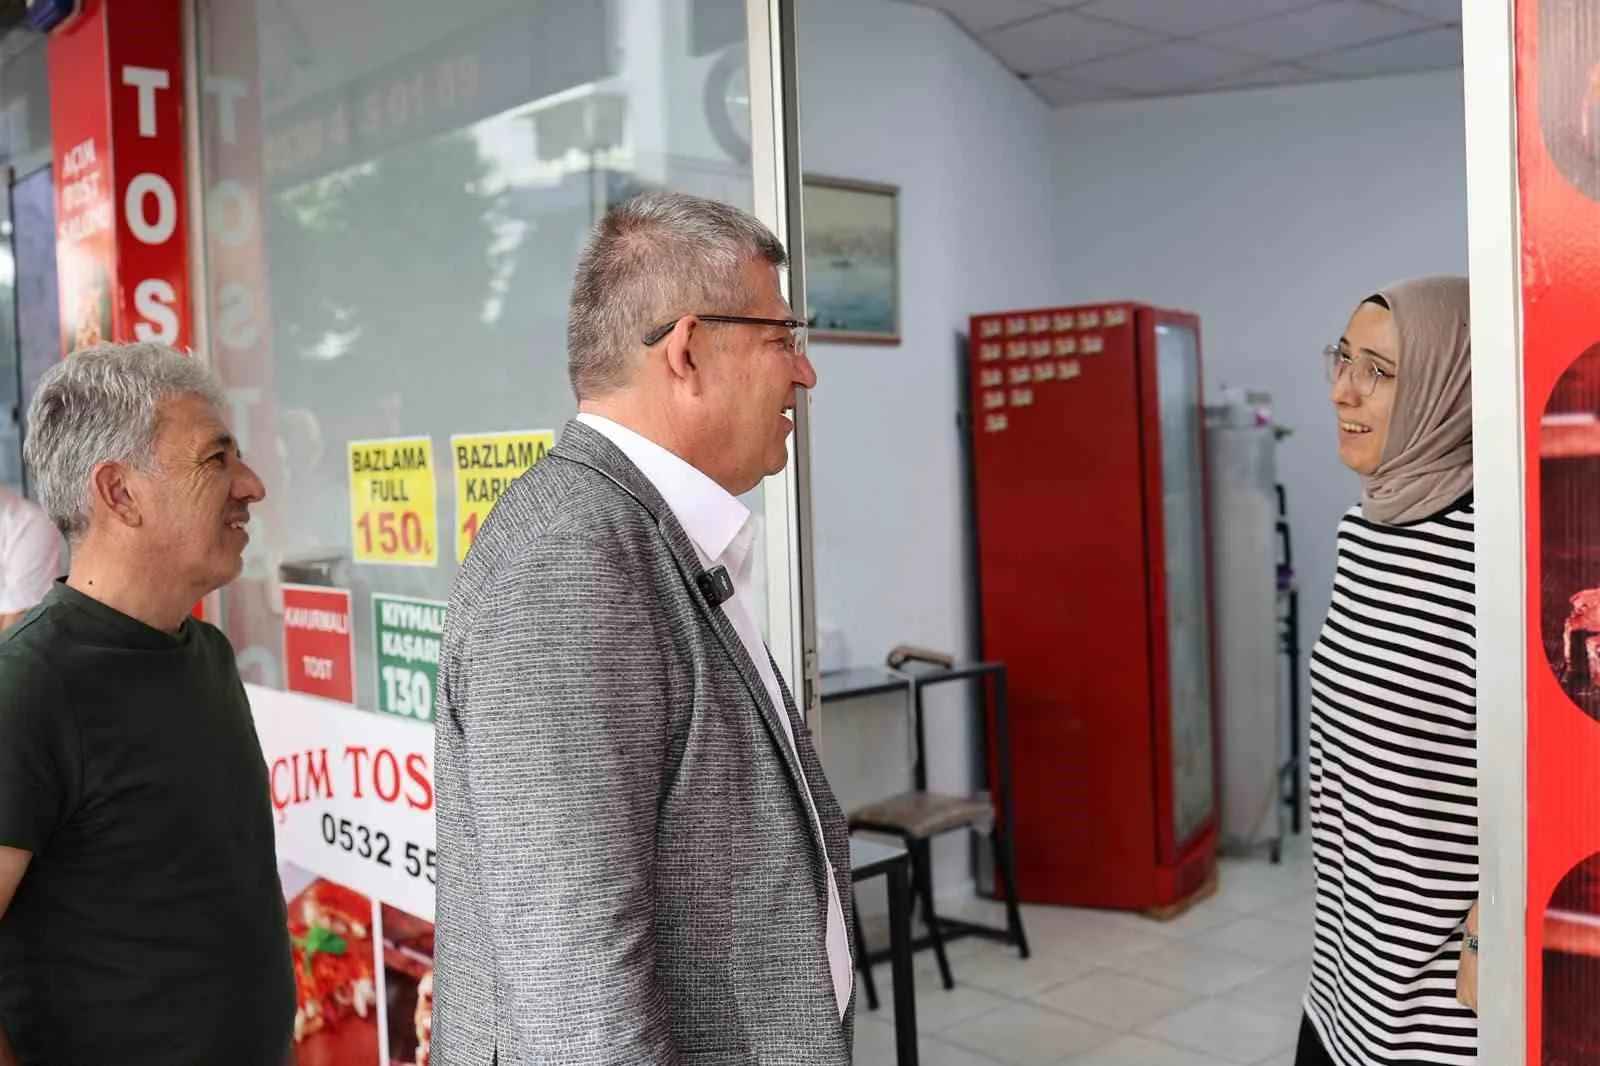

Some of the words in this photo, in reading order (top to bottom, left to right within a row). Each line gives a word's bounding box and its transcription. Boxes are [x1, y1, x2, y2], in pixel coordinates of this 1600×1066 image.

[122, 66, 179, 345] TOS
[353, 447, 427, 473] BAZLAMA
[456, 441, 547, 470] BAZLAMA
[370, 480, 409, 502] FULL
[466, 478, 518, 502] KARI
[462, 512, 478, 544] 1
[302, 655, 333, 680] TOST
[382, 665, 432, 720] 130
[271, 748, 334, 825] ÇIM
[344, 746, 434, 811] TOS
[322, 813, 392, 867] 0532
[405, 841, 436, 884] 55
